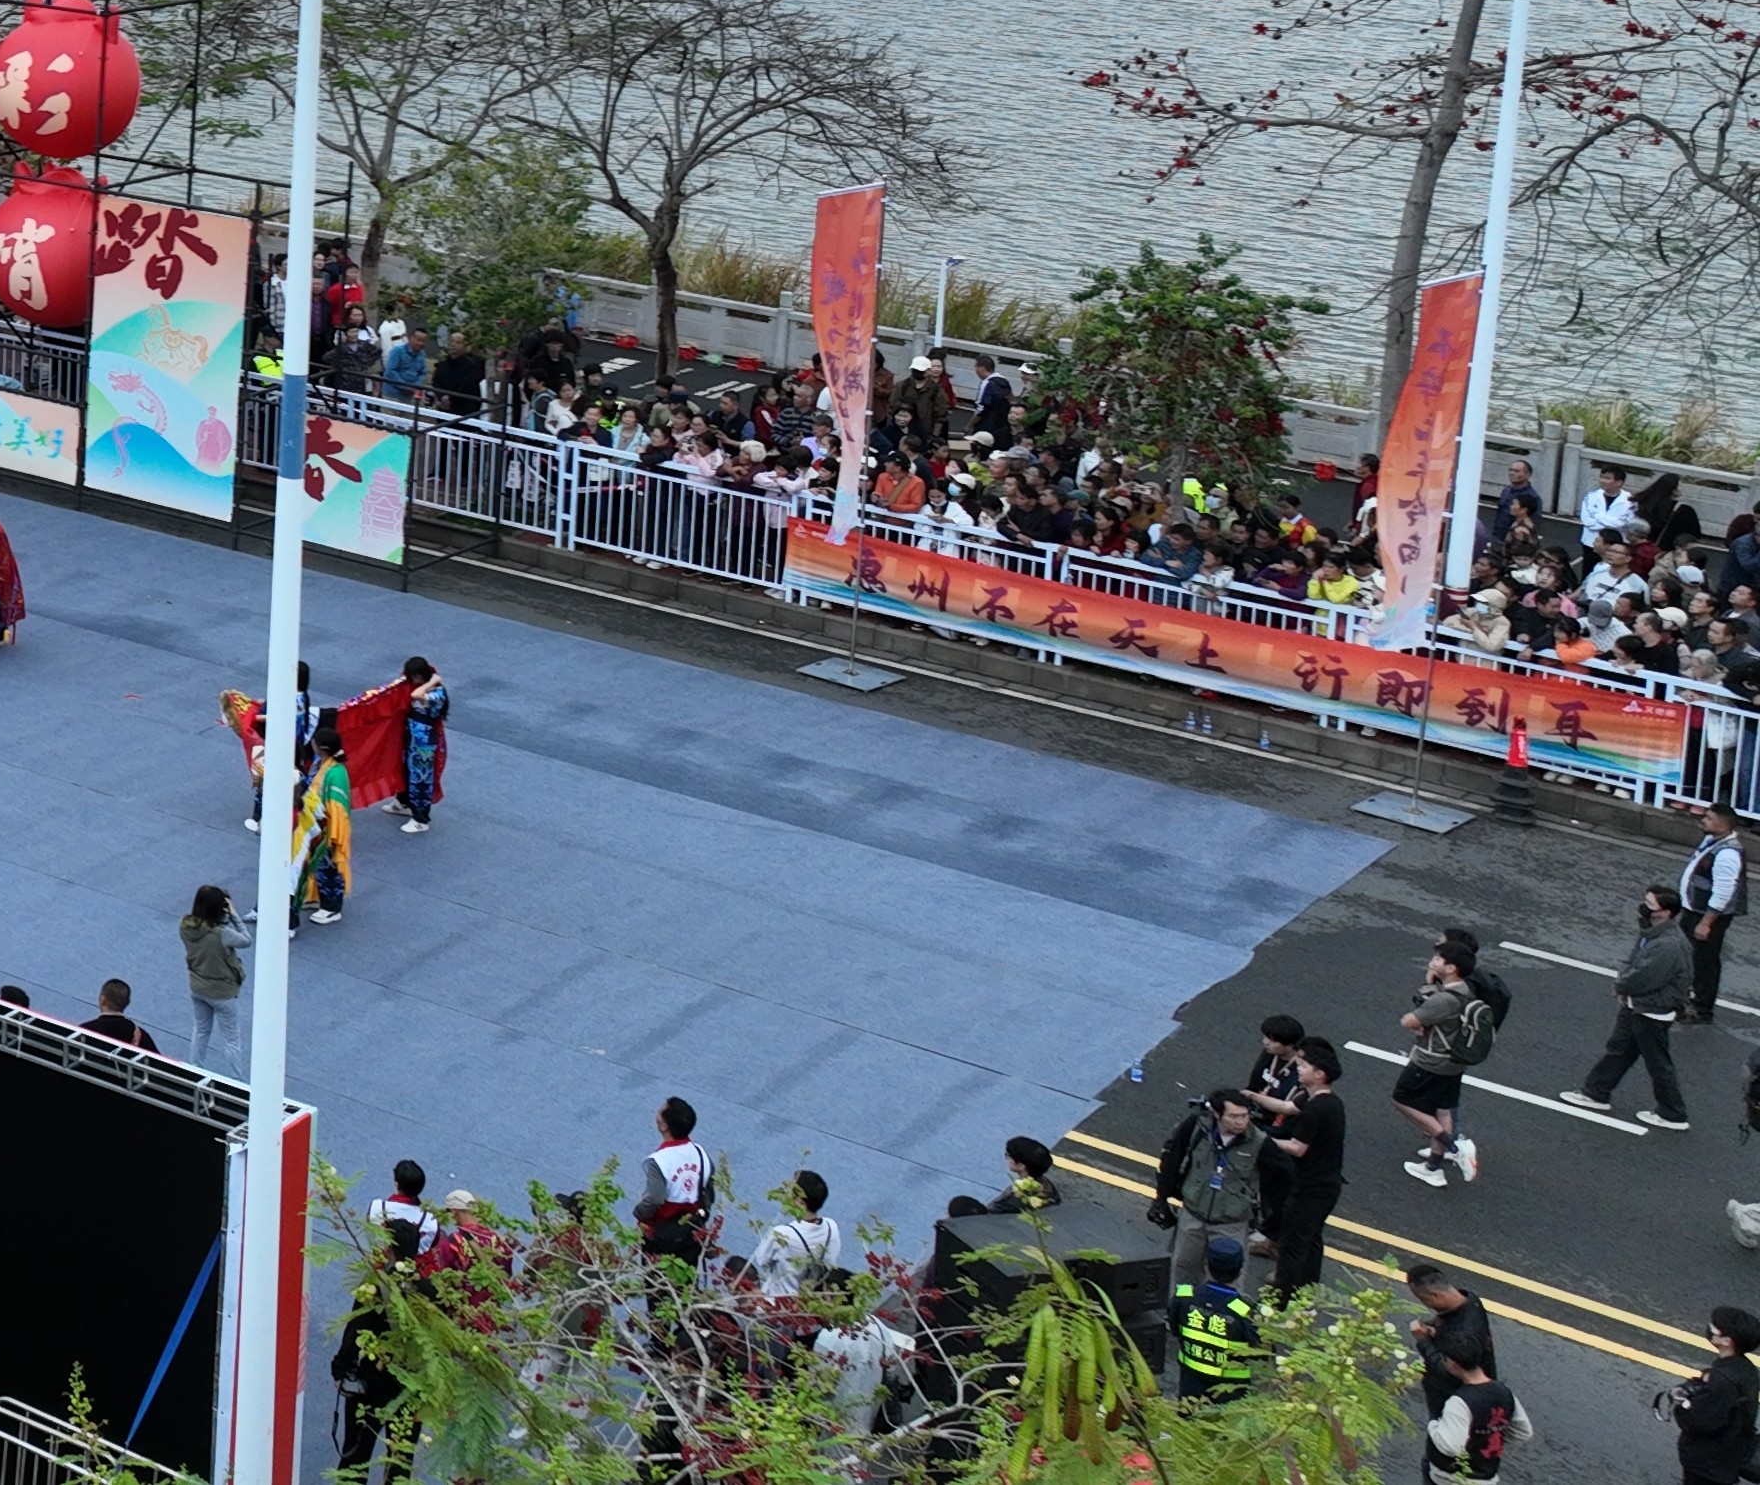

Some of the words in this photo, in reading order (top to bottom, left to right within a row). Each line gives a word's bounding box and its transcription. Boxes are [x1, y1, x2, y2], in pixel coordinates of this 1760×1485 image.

[93, 203, 219, 300] 踏
[844, 545, 1228, 675] 惠州不在天上
[1292, 653, 1598, 752] 行即到耳
[1188, 1308, 1227, 1336] 金彪
